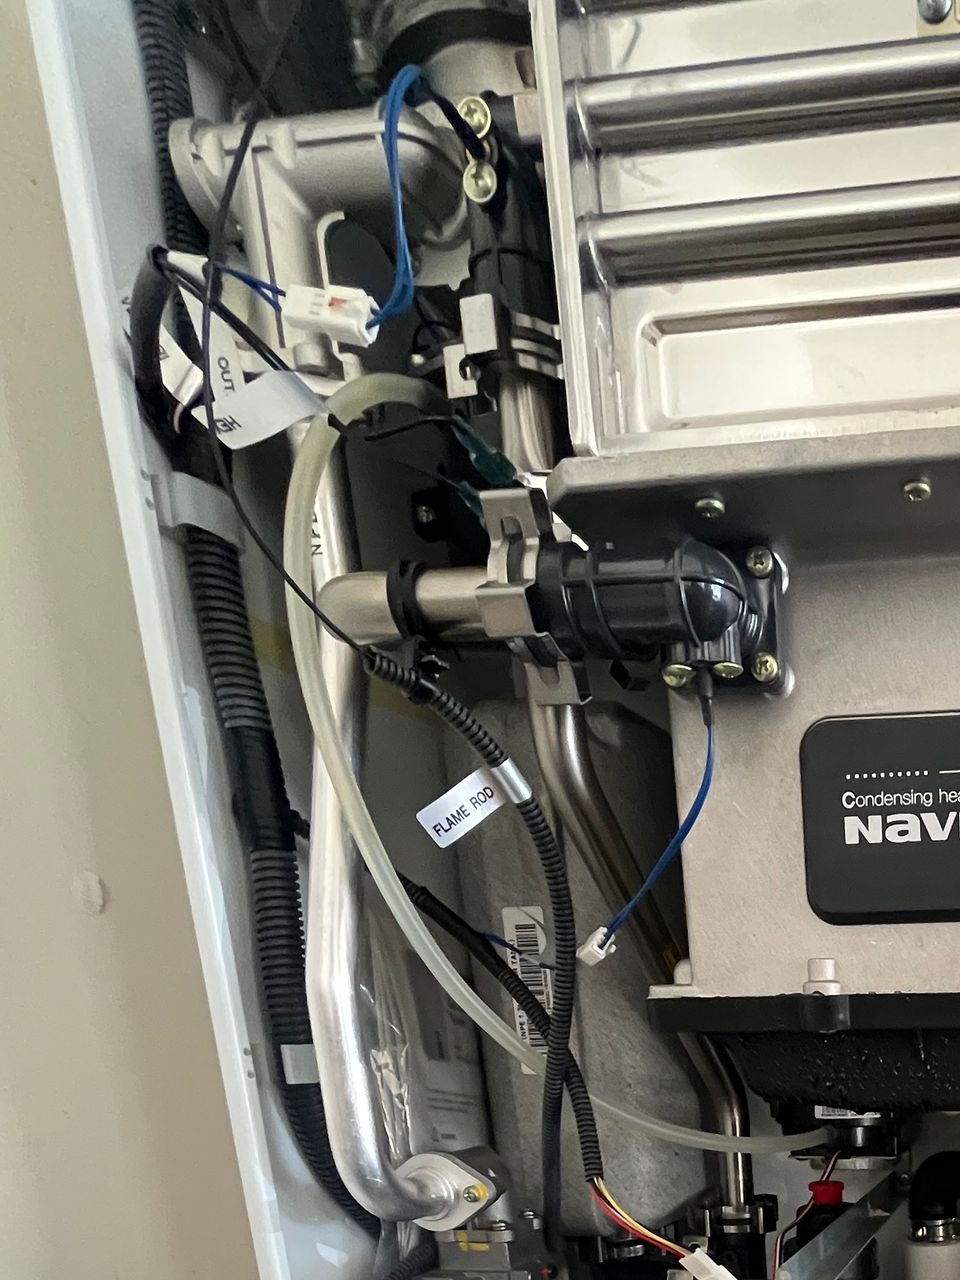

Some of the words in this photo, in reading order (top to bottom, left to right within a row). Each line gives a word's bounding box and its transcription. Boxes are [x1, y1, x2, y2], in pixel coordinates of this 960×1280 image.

[217, 356, 236, 392] OUT
[432, 804, 471, 837] FLAME
[469, 786, 494, 810] ROD
[842, 788, 933, 809] Condensing
